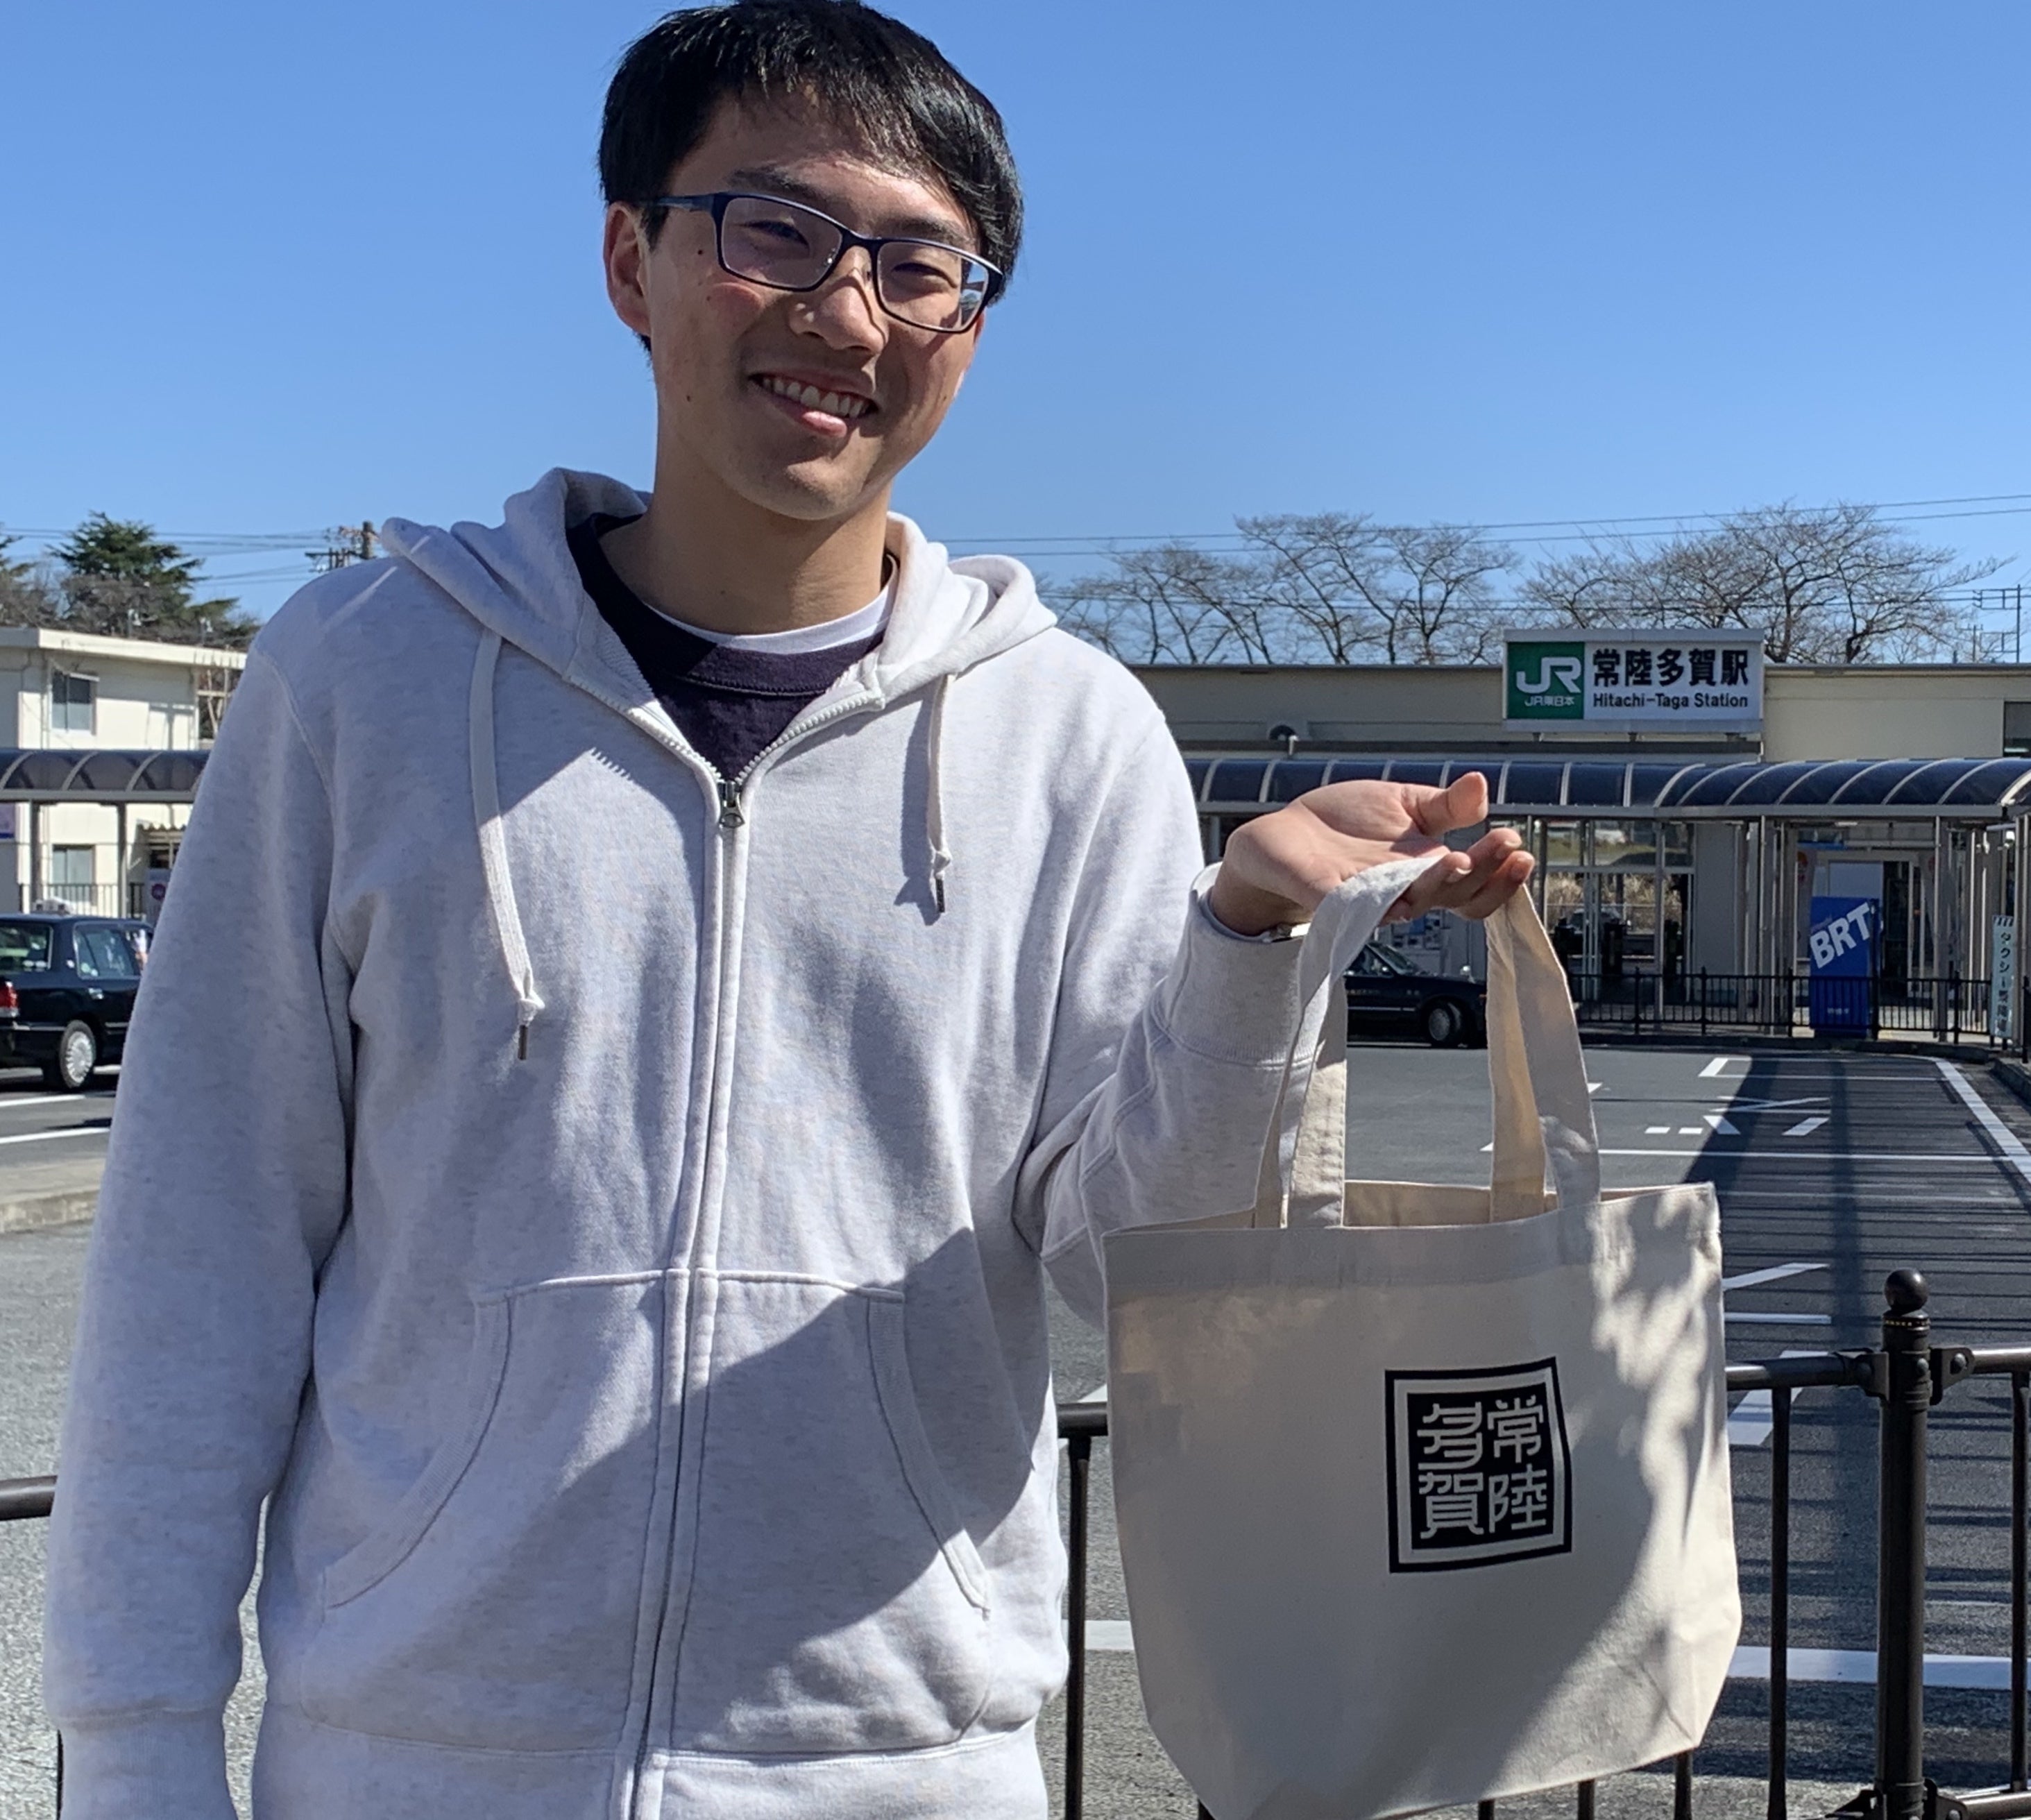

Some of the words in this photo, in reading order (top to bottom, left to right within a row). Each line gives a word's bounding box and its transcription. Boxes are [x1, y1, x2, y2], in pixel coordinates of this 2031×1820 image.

[1516, 656, 1581, 693] JR
[1592, 648, 1749, 687] 常陸多賀駅
[1593, 692, 1689, 710] Hitachi-Taga
[1694, 693, 1747, 708] Station
[1810, 902, 1870, 969] BRT
[1417, 1401, 1484, 1539] 多賀
[1487, 1394, 1547, 1533] 常陸
